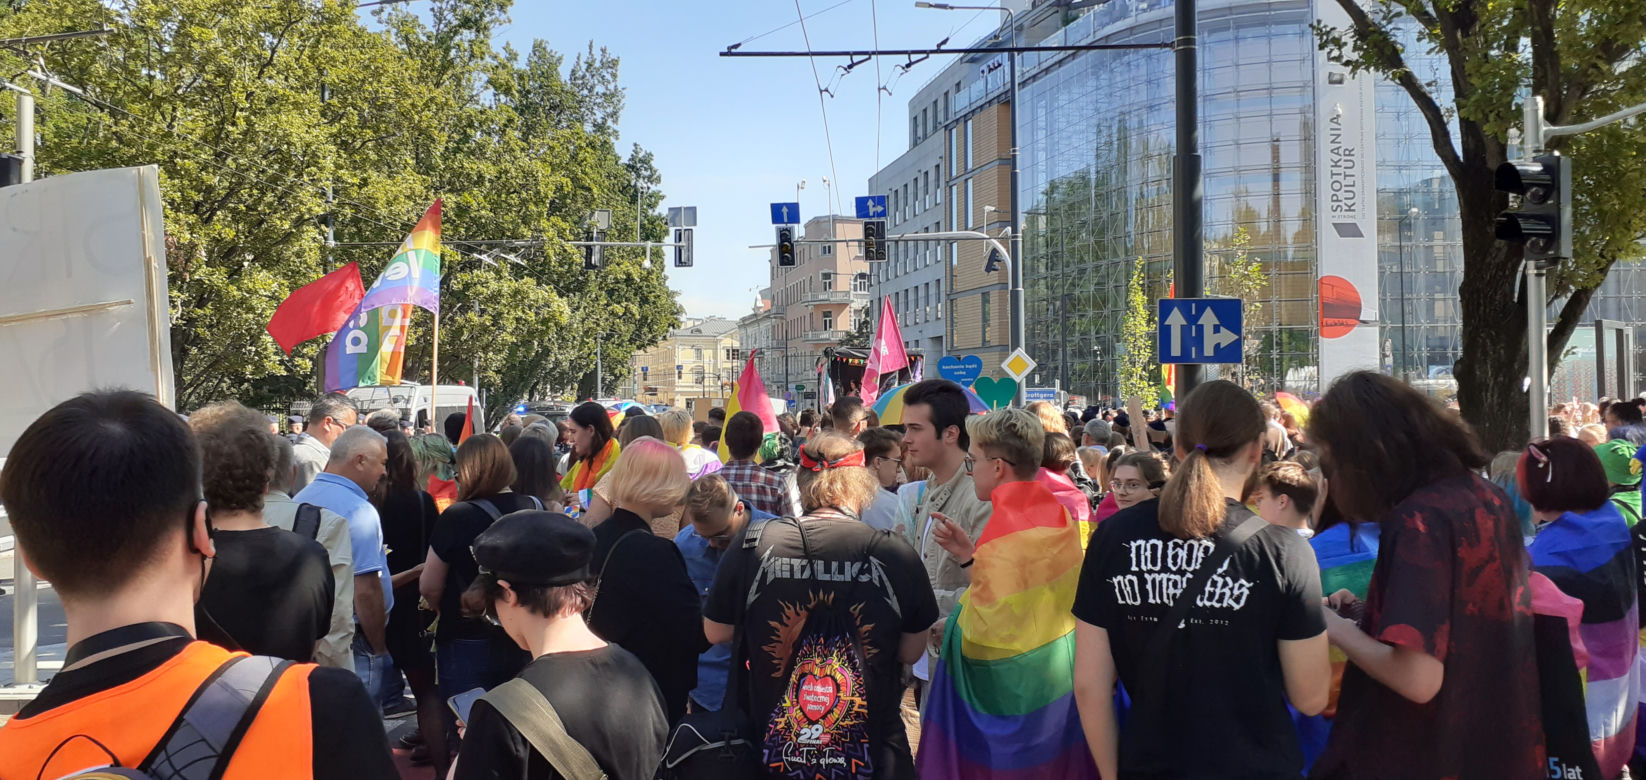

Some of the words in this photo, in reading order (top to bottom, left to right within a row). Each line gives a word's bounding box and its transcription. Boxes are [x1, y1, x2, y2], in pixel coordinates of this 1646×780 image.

[1330, 116, 1343, 212] SPOTKANIA
[1343, 147, 1356, 213] KULTUR
[746, 544, 902, 620] METALLICA
[1130, 539, 1163, 571] NO
[1112, 573, 1142, 606] NO
